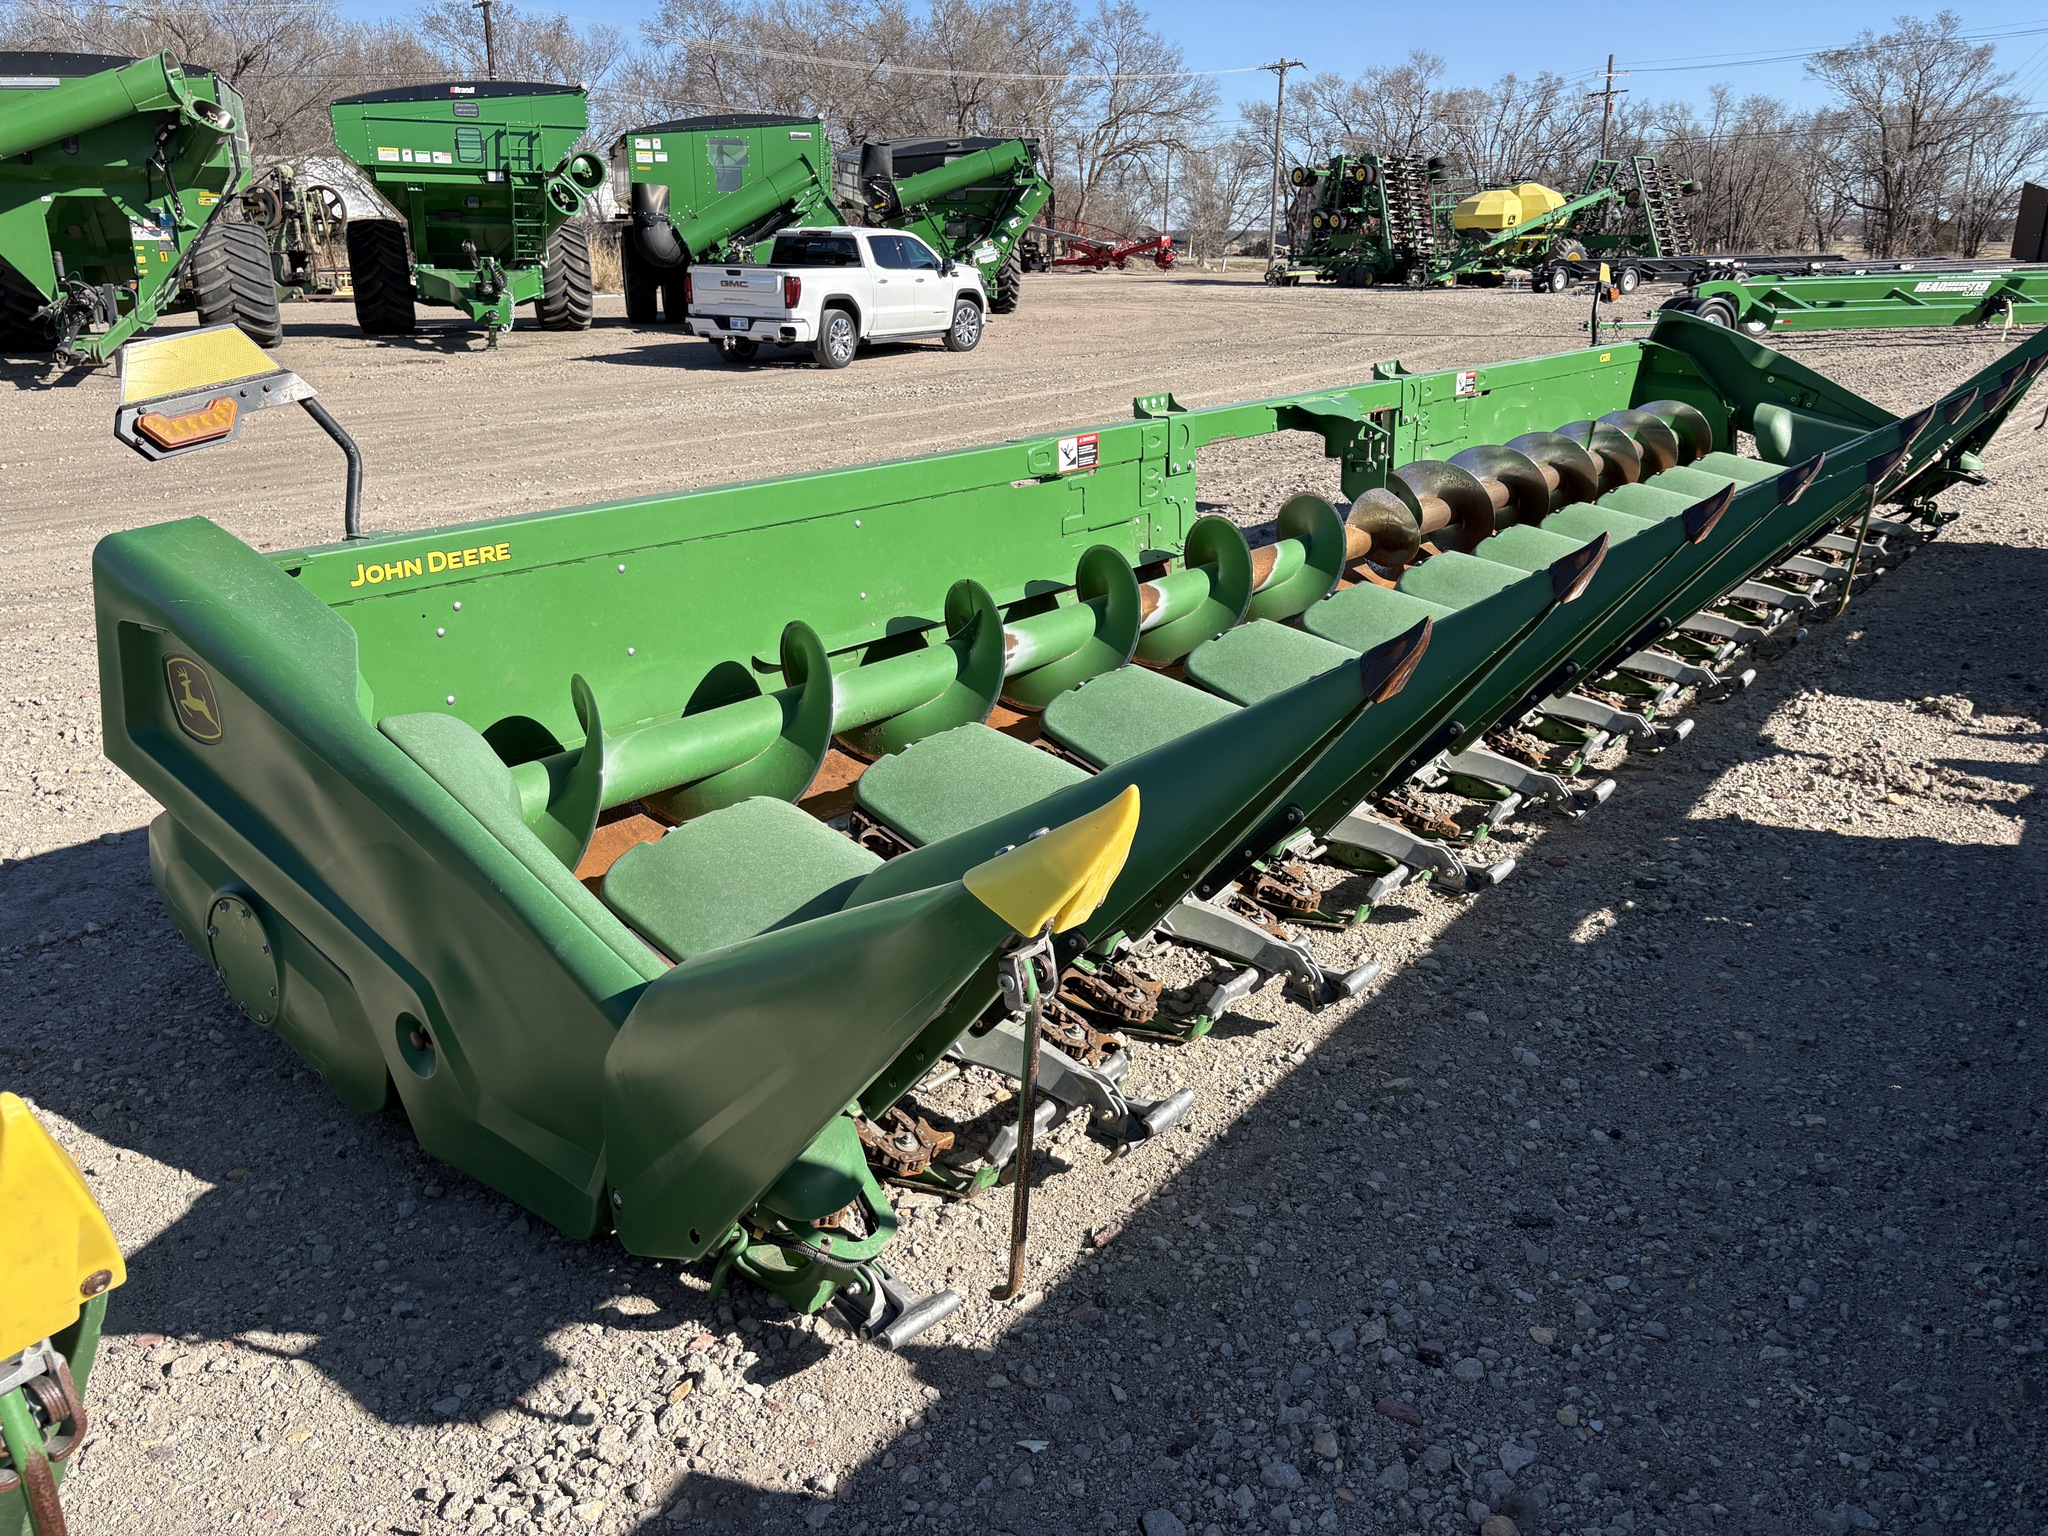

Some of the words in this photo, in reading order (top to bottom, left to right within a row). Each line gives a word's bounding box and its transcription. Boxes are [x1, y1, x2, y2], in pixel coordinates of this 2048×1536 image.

[454, 86, 475, 94] Brandt
[720, 280, 749, 288] GMC
[1913, 281, 1992, 293] HEADHUNTER
[350, 557, 423, 588] JOHN
[427, 542, 512, 573] DEERE
